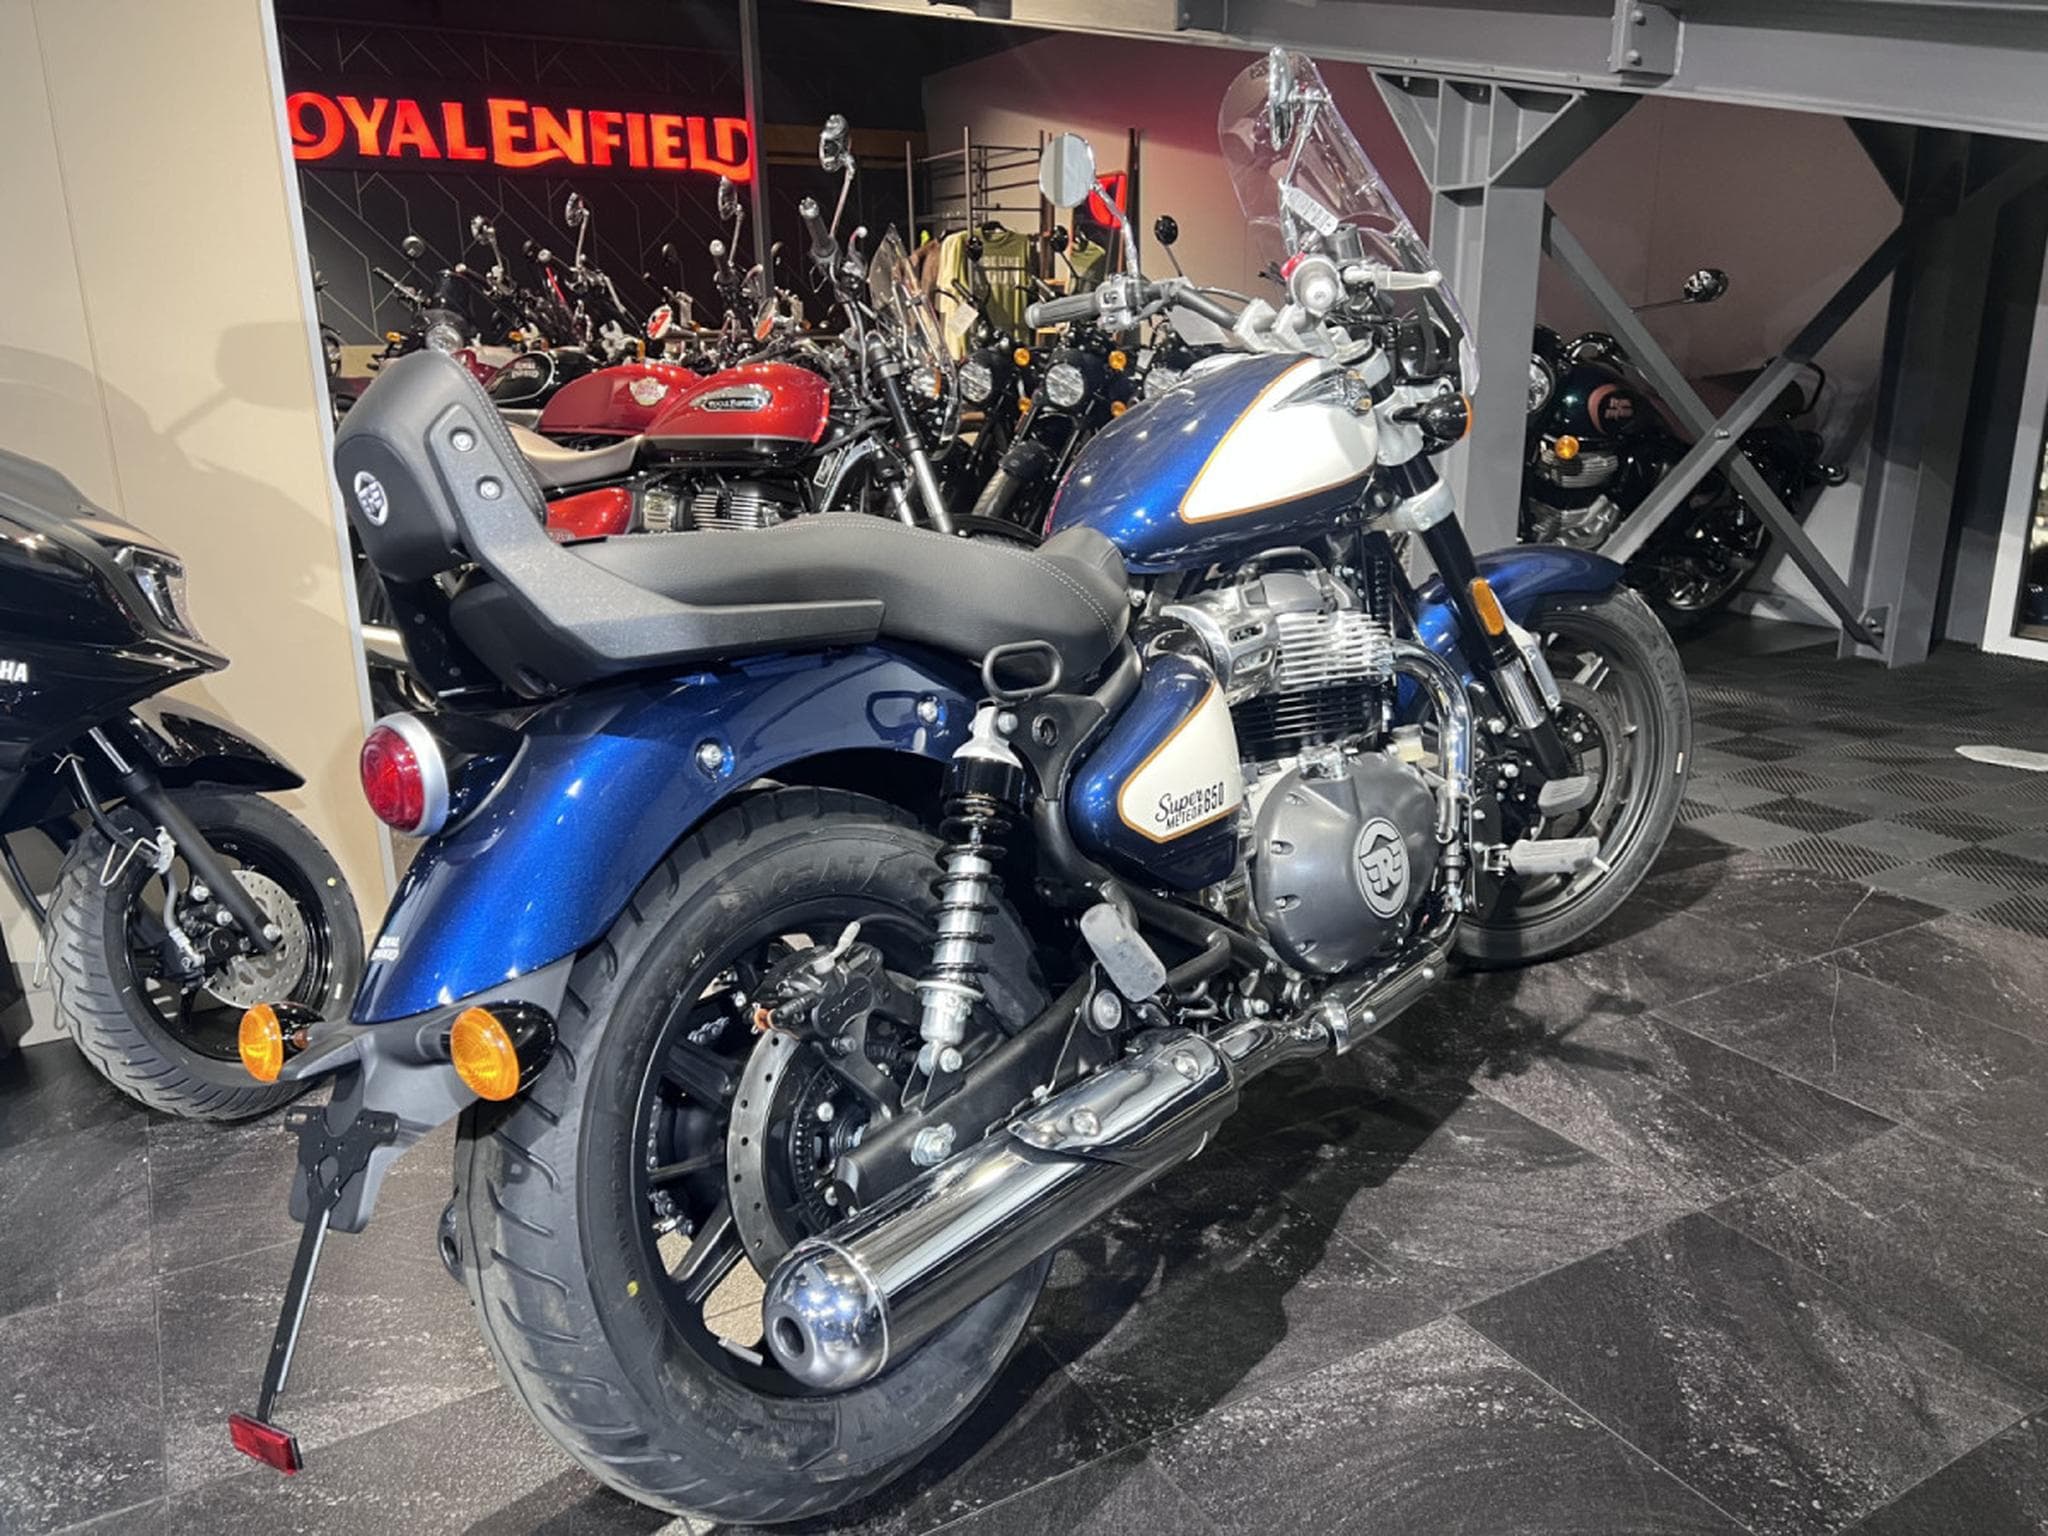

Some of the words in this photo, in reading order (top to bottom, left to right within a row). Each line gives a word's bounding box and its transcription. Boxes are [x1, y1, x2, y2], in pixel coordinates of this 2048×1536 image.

[286, 90, 487, 160] OYAL
[487, 97, 752, 182] ENFIELD
[1154, 788, 1203, 823] Super
[1204, 781, 1225, 813] 650
[1165, 804, 1202, 831] METEOR
